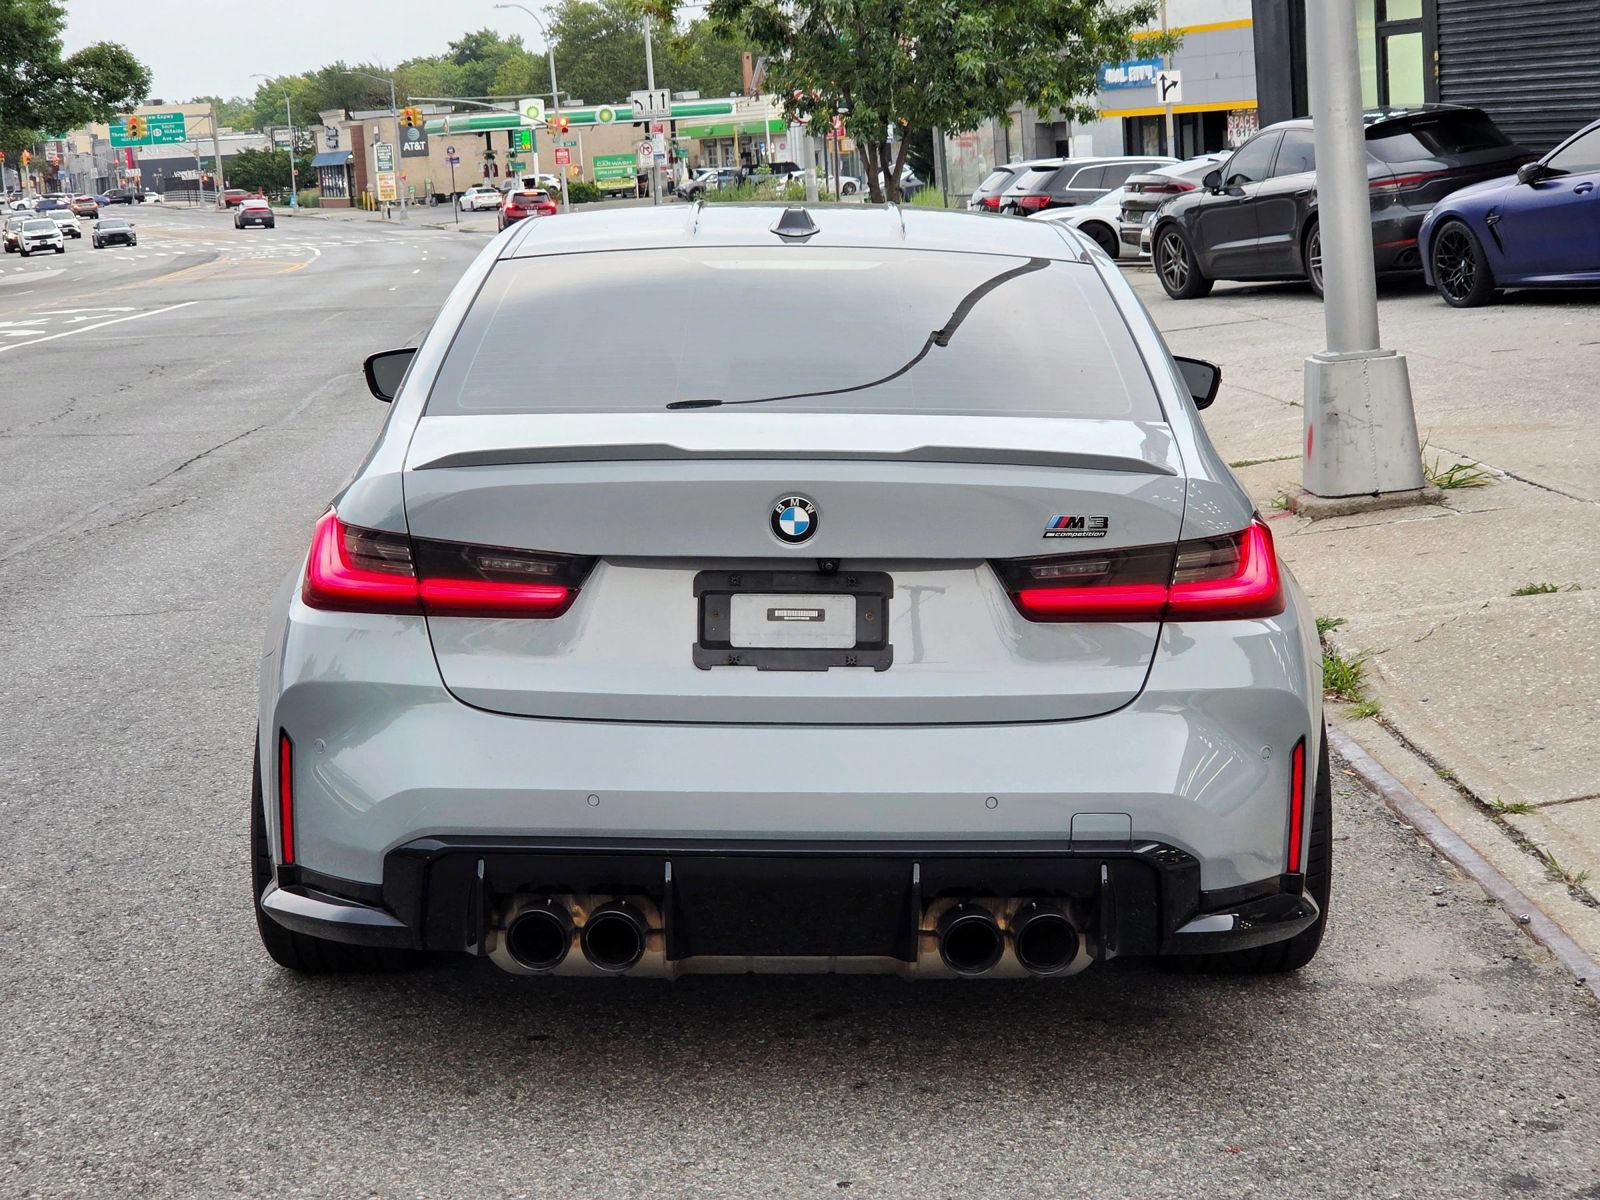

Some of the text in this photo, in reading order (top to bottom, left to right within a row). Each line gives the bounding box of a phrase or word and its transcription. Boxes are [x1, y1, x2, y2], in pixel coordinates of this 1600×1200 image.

[1228, 115, 1255, 129] SPACE
[403, 141, 426, 151] AT&T
[775, 498, 815, 514] BMW
